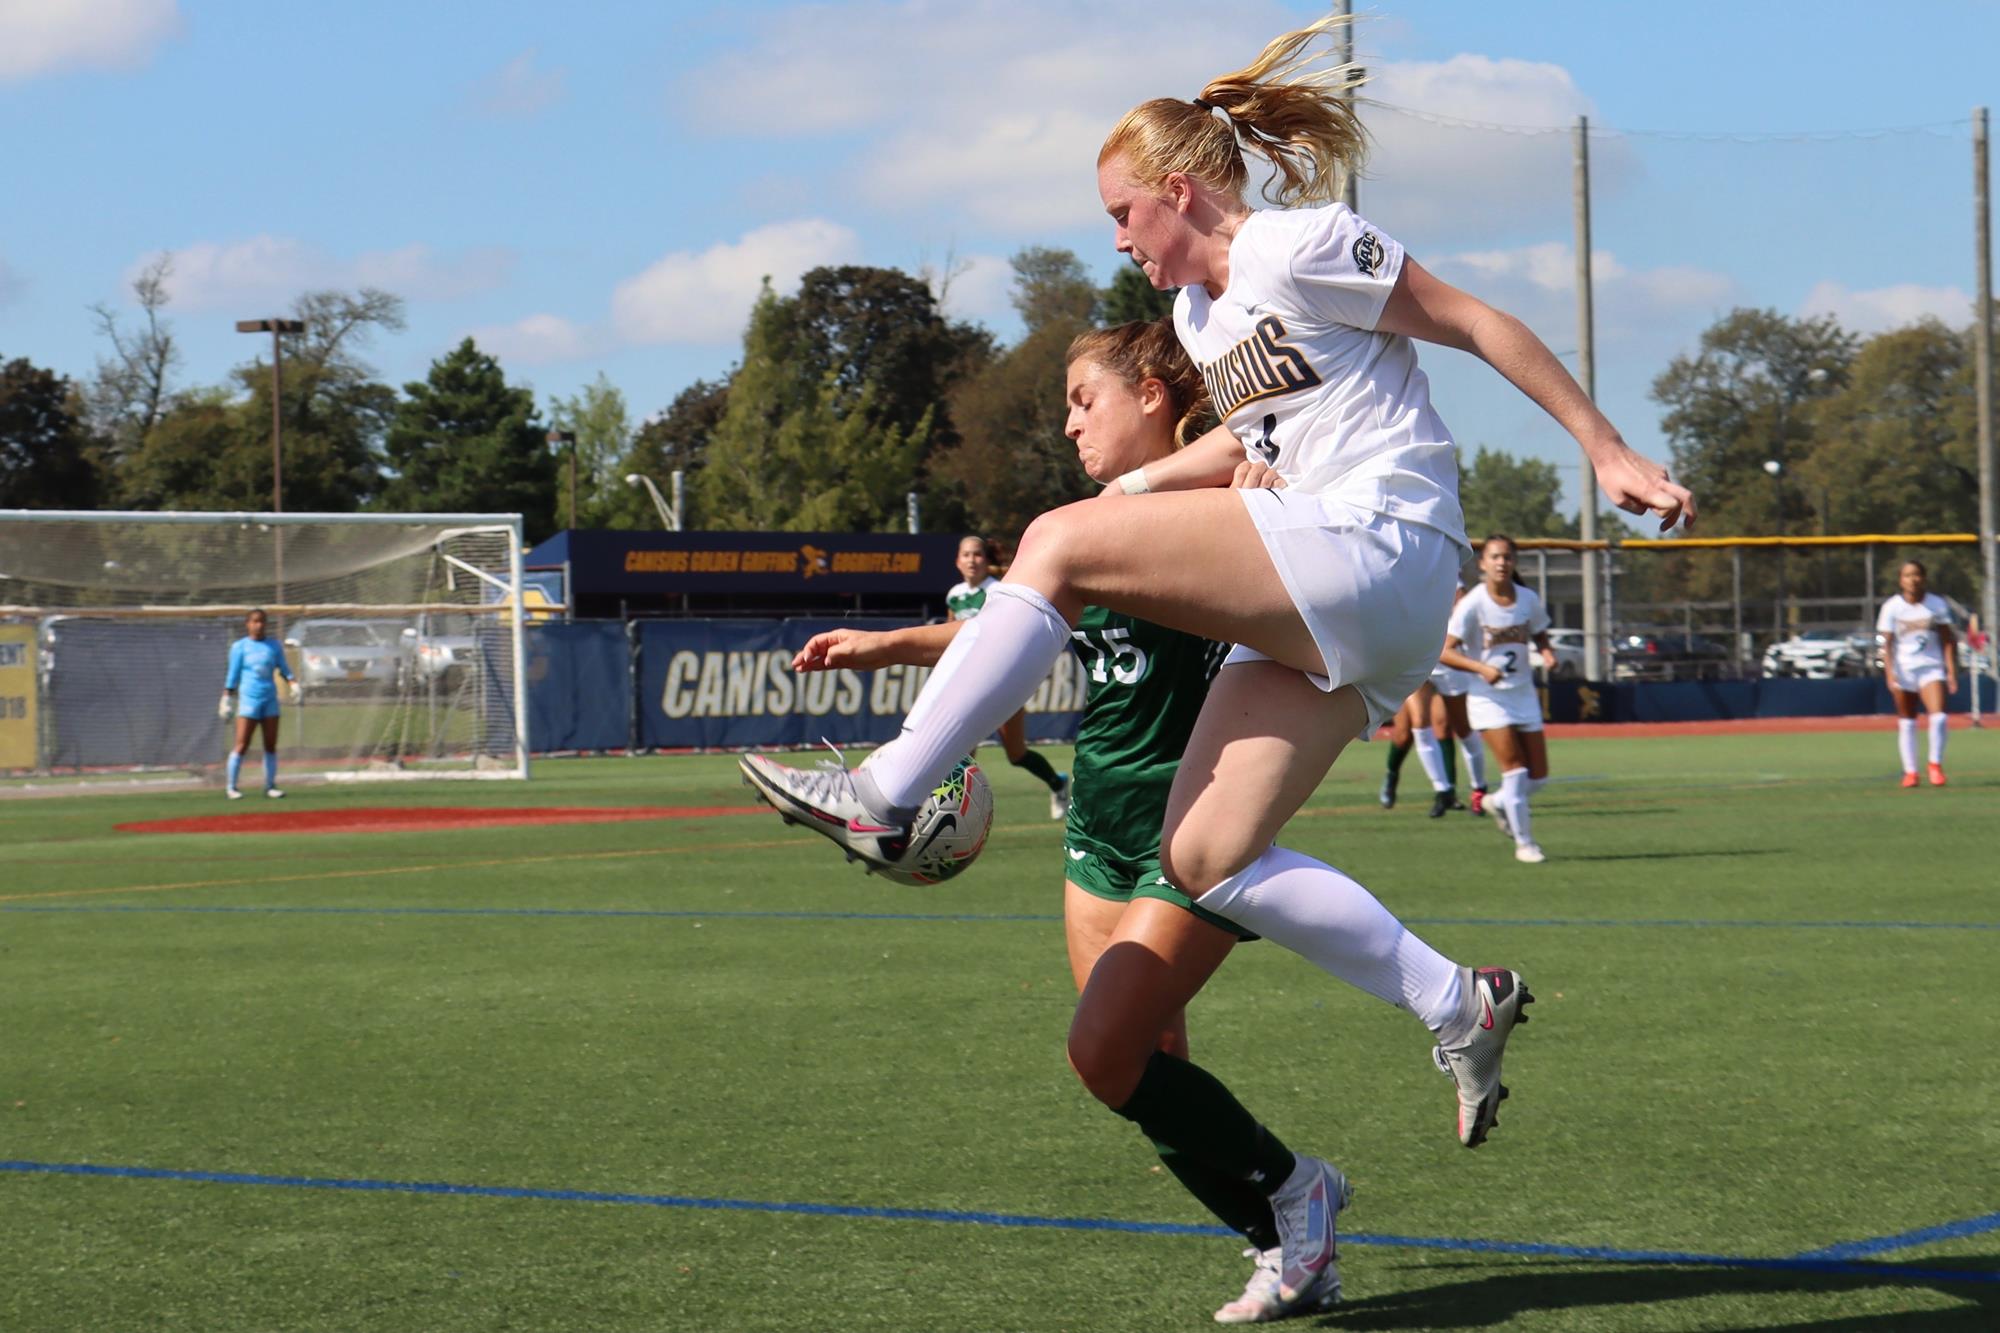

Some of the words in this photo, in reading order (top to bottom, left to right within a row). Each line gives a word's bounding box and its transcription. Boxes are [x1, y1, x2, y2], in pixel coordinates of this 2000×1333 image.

[1358, 231, 1377, 279] MAAC
[1198, 315, 1323, 423] ANISIUS
[1072, 627, 1147, 684] 15
[1504, 651, 1517, 672] 2
